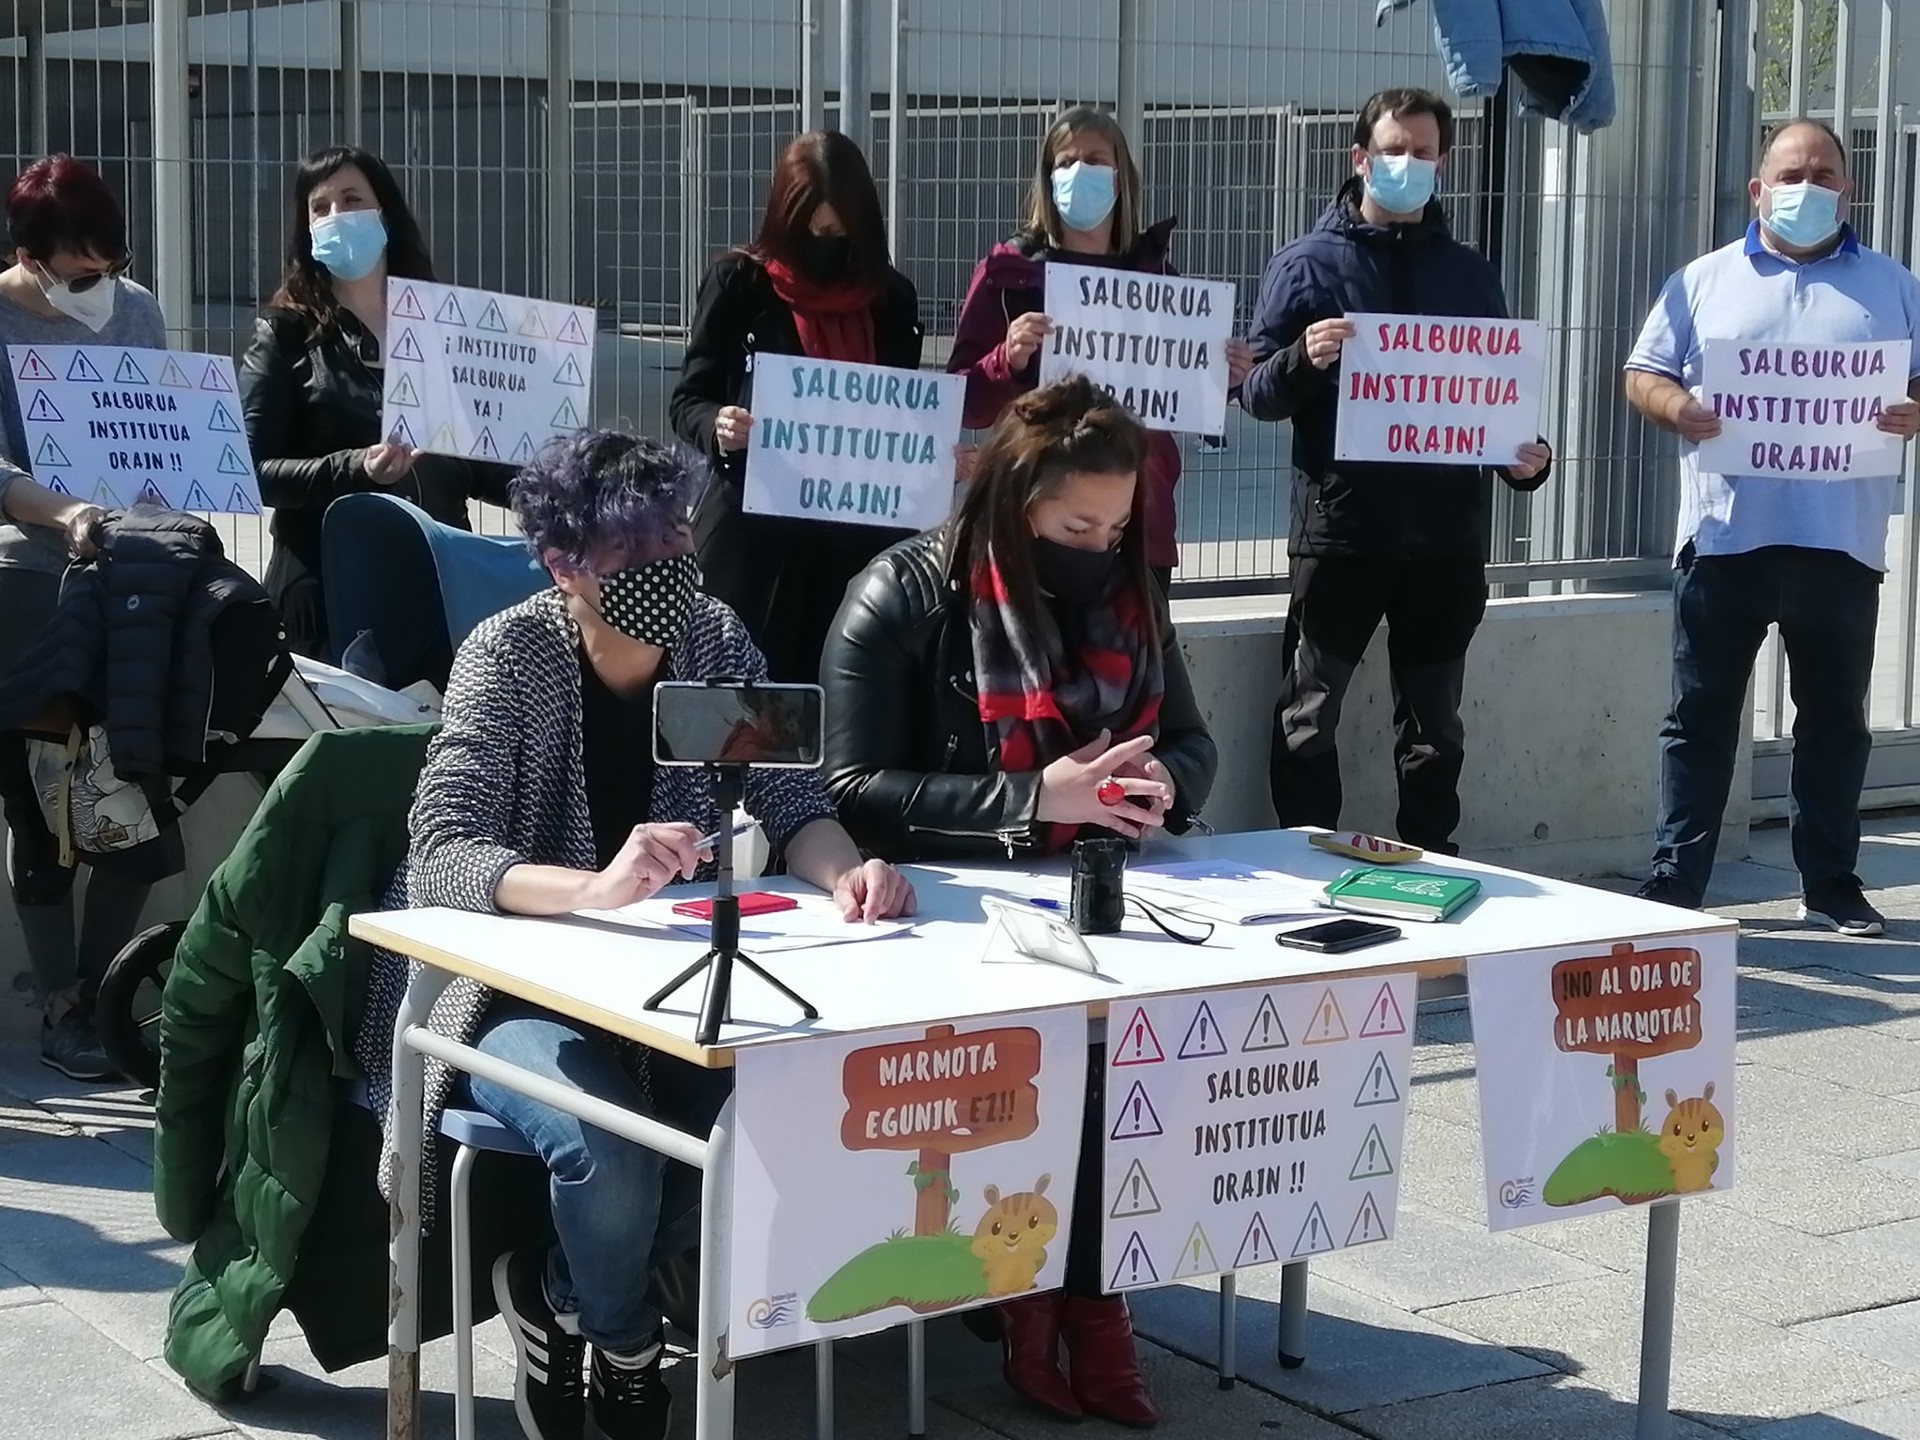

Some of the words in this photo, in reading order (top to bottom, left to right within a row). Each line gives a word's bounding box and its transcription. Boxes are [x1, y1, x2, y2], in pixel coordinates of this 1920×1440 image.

[1079, 275, 1212, 318] SALBURUA
[457, 335, 537, 365] INSTITUTO
[1052, 324, 1209, 370] INSTITUTUA
[1378, 322, 1522, 356] SALBURUA
[452, 365, 527, 392] SALBURUA
[1739, 347, 1886, 379] SALBURUA
[91, 390, 178, 413] SALBURUA
[792, 365, 941, 411] SALBURUA
[1094, 382, 1179, 423] RAIN!
[1349, 371, 1519, 406] INSTITUTUA
[473, 398, 490, 418] YA
[1712, 392, 1884, 426] INSTITUTUA
[88, 420, 191, 442] INSTITUTUA
[760, 416, 937, 465] INSTITUTUA
[1387, 423, 1485, 457] ORAIN!
[108, 451, 165, 471] ORAIN
[1751, 441, 1853, 473] ORAIN!
[799, 477, 902, 519] ORAIN!
[1599, 967, 1624, 997] AL
[1629, 962, 1664, 993] DIA
[1669, 960, 1694, 988] DE
[1564, 1013, 1589, 1048] LA
[1594, 1004, 1692, 1043] MARMOTA!
[878, 1042, 998, 1088] MARMOTA
[1206, 1058, 1320, 1104] SALBURUA
[865, 1096, 959, 1140] EGUNIK
[968, 1089, 1017, 1125] EZ!!
[1193, 1107, 1327, 1157] INSTITUTUA
[1212, 1165, 1281, 1206] ORAIN
